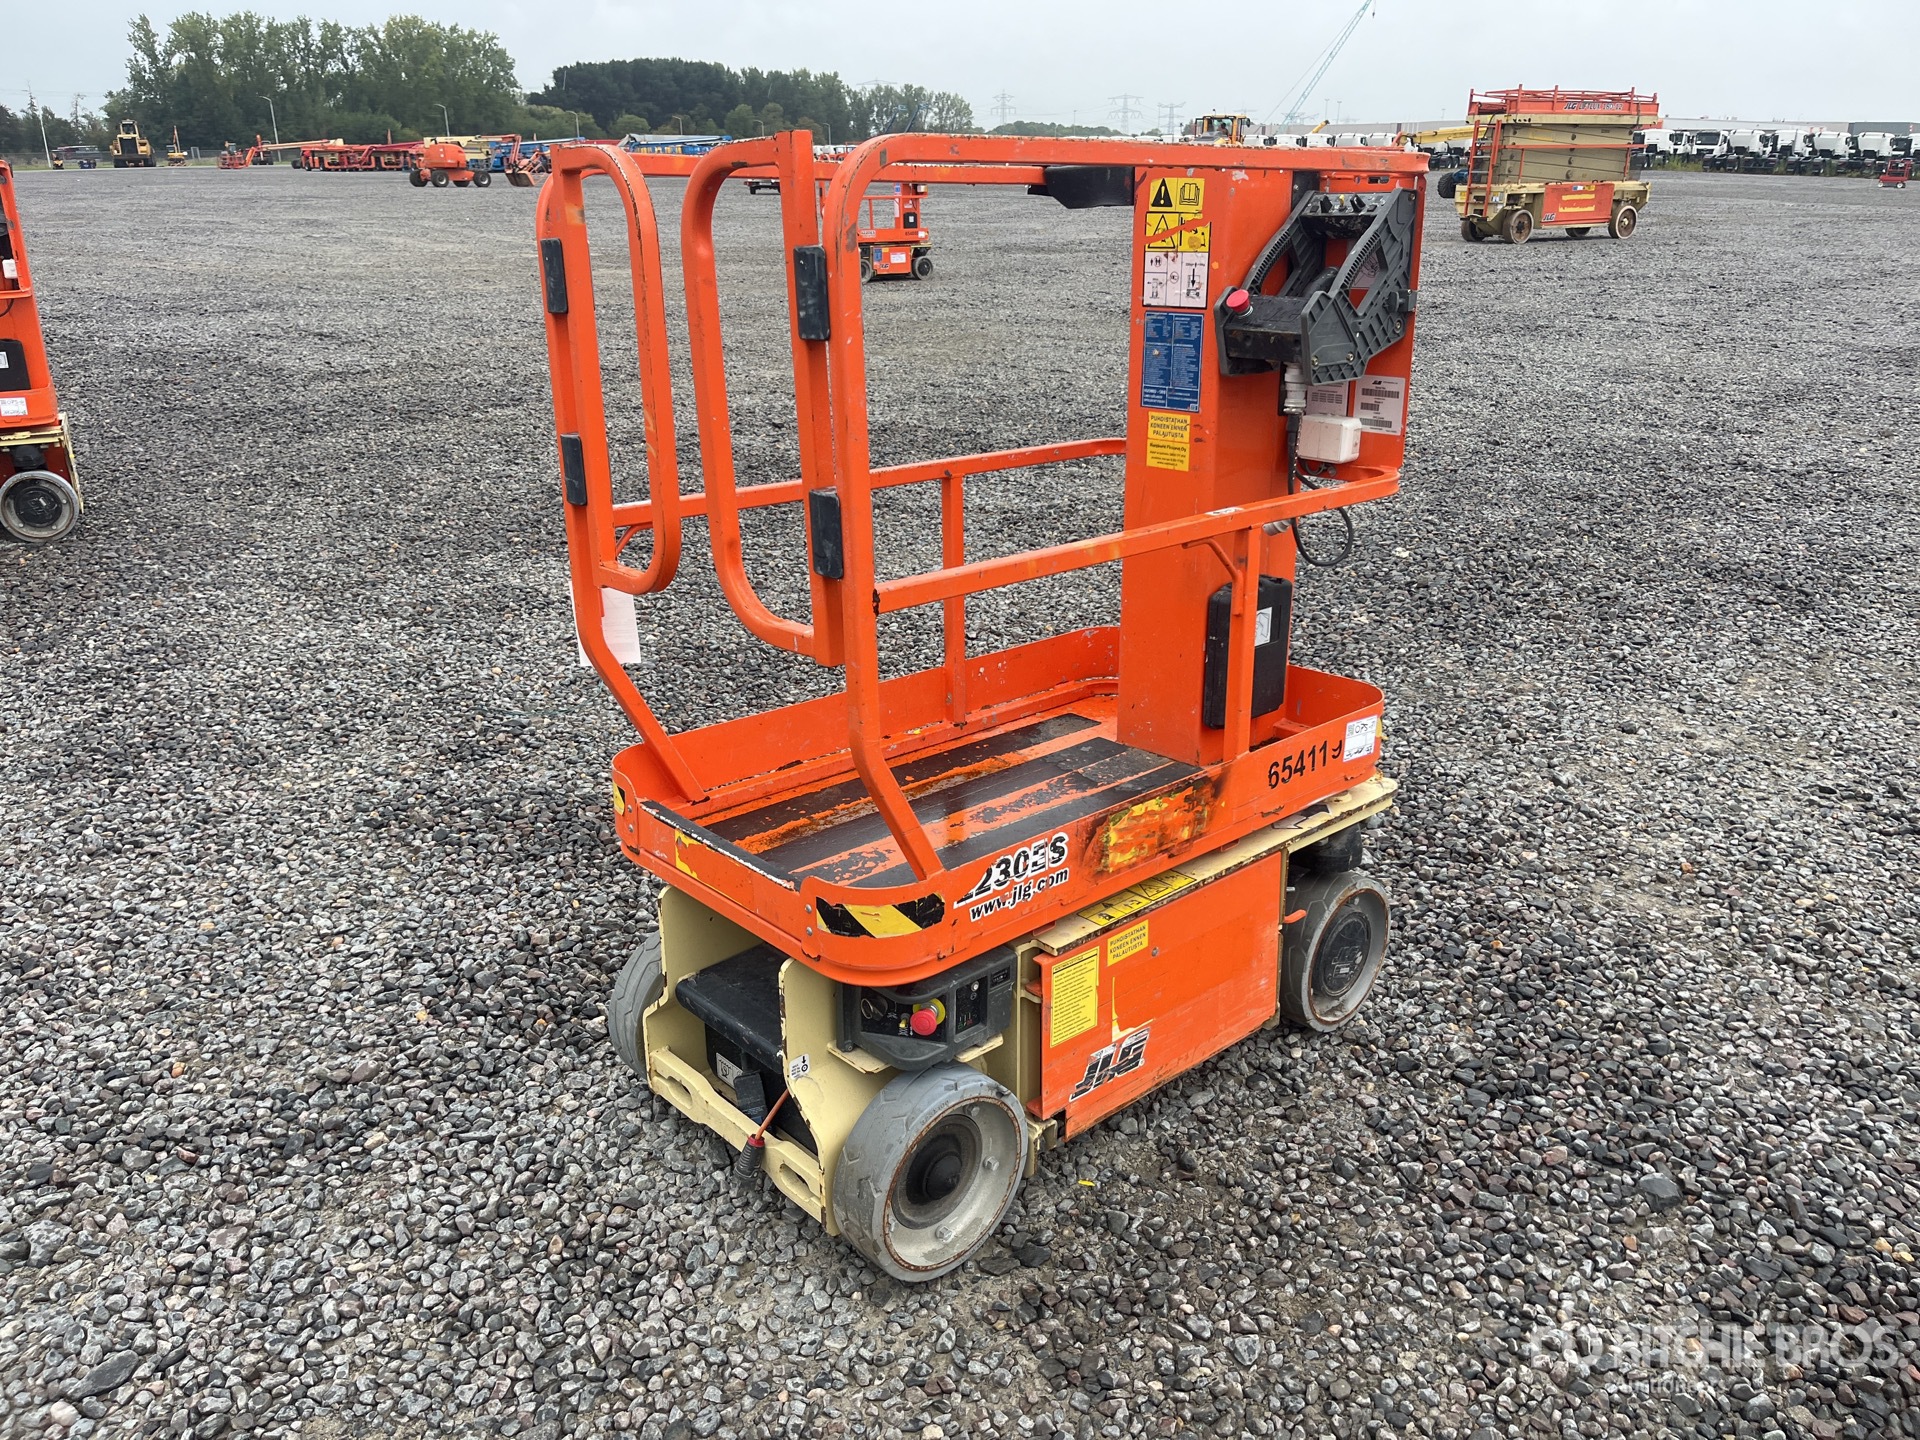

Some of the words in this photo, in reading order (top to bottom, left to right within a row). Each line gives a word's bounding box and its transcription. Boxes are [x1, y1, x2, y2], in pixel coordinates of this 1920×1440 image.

[1564, 102, 1577, 110] JLG
[1543, 213, 1556, 221] JLG
[971, 869, 1068, 920] www.jlg.com
[1130, 932, 1146, 944] ENNEN
[1112, 941, 1143, 959] PALAUTUSTA
[1070, 1028, 1149, 1101] JLG
